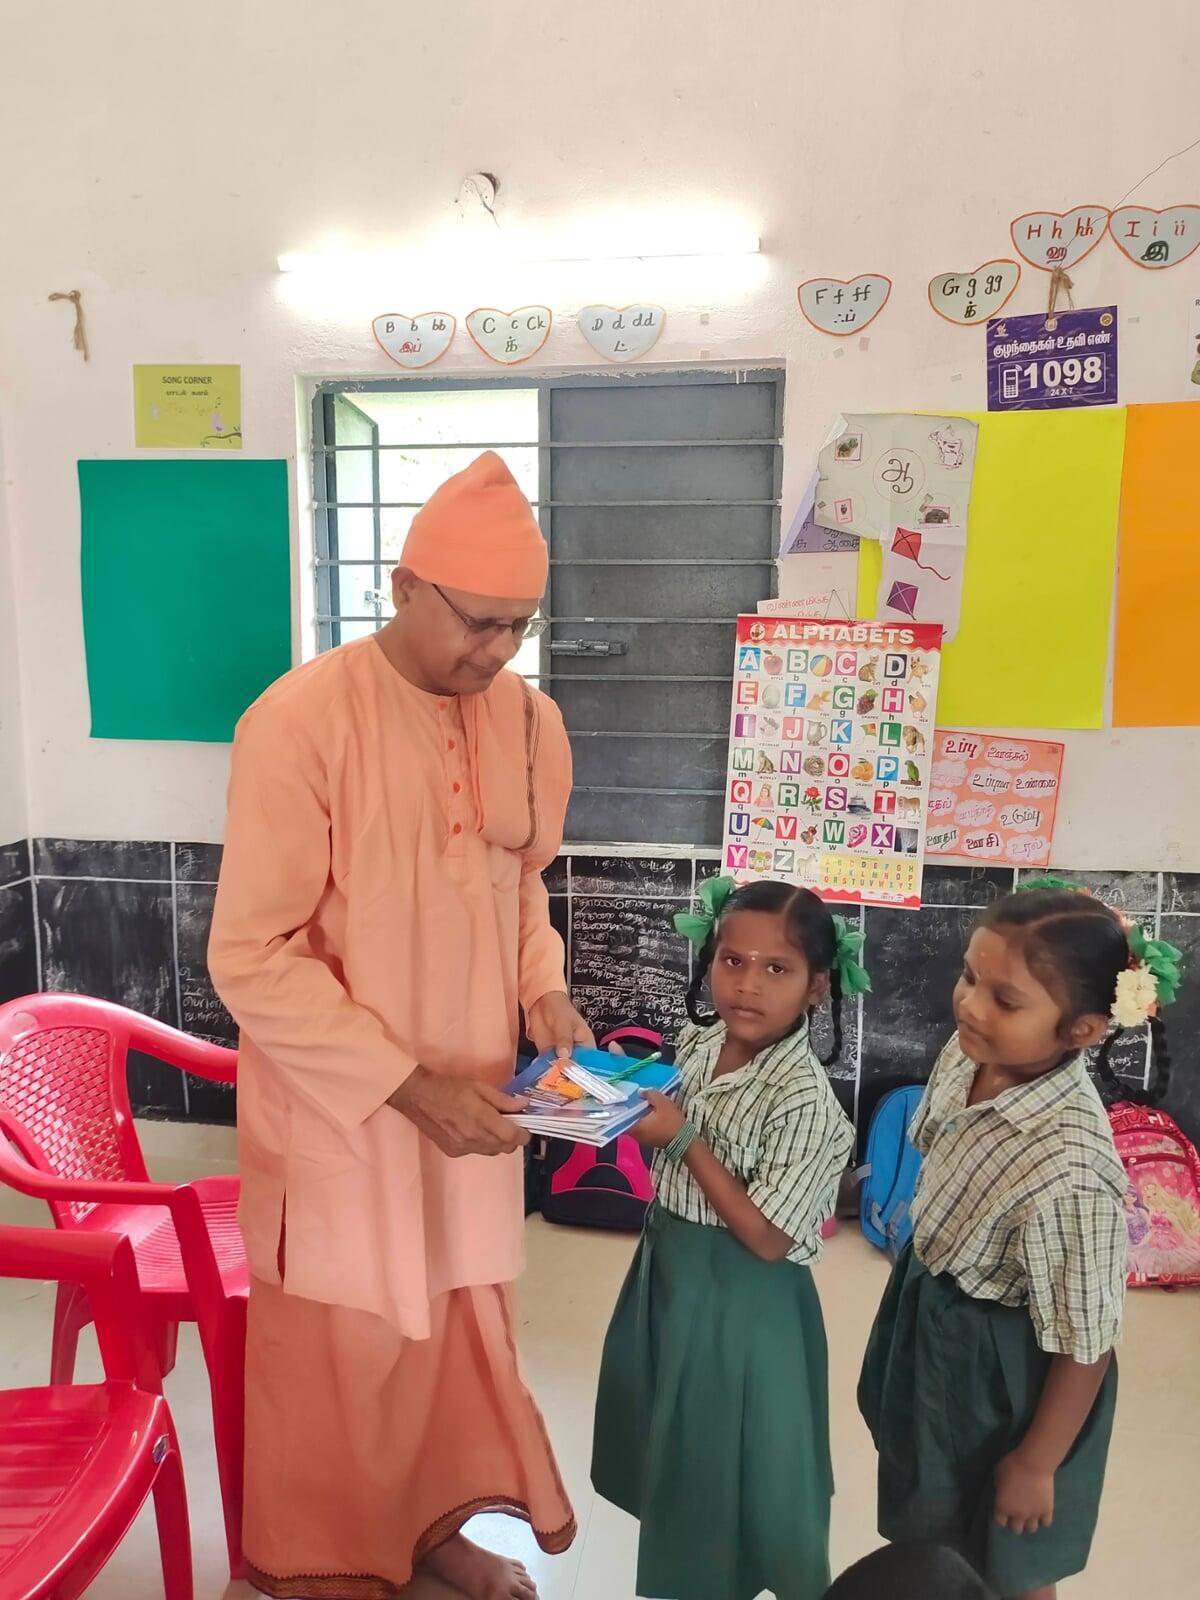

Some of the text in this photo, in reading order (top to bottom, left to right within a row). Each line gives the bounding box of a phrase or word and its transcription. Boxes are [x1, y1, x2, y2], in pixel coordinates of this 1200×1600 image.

[1027, 217, 1094, 240] H h hh
[1125, 220, 1185, 238] I i ii
[816, 284, 871, 304] F f ff
[942, 275, 1003, 298] G g gg
[386, 319, 446, 333] B b bb
[482, 317, 496, 334] C
[511, 319, 519, 329] c
[591, 312, 655, 331] D d dd
[162, 376, 212, 384] SONG CORNER
[1023, 356, 1102, 389] 1098
[773, 624, 915, 644] ALPHABETS
[740, 650, 905, 676] A B C D
[740, 682, 902, 712] E F G H
[743, 716, 898, 745] I J K L
[734, 749, 896, 778] M N O P
[733, 781, 894, 813] Q R S T
[731, 814, 892, 846] U V W X
[729, 847, 792, 870] Y Z
